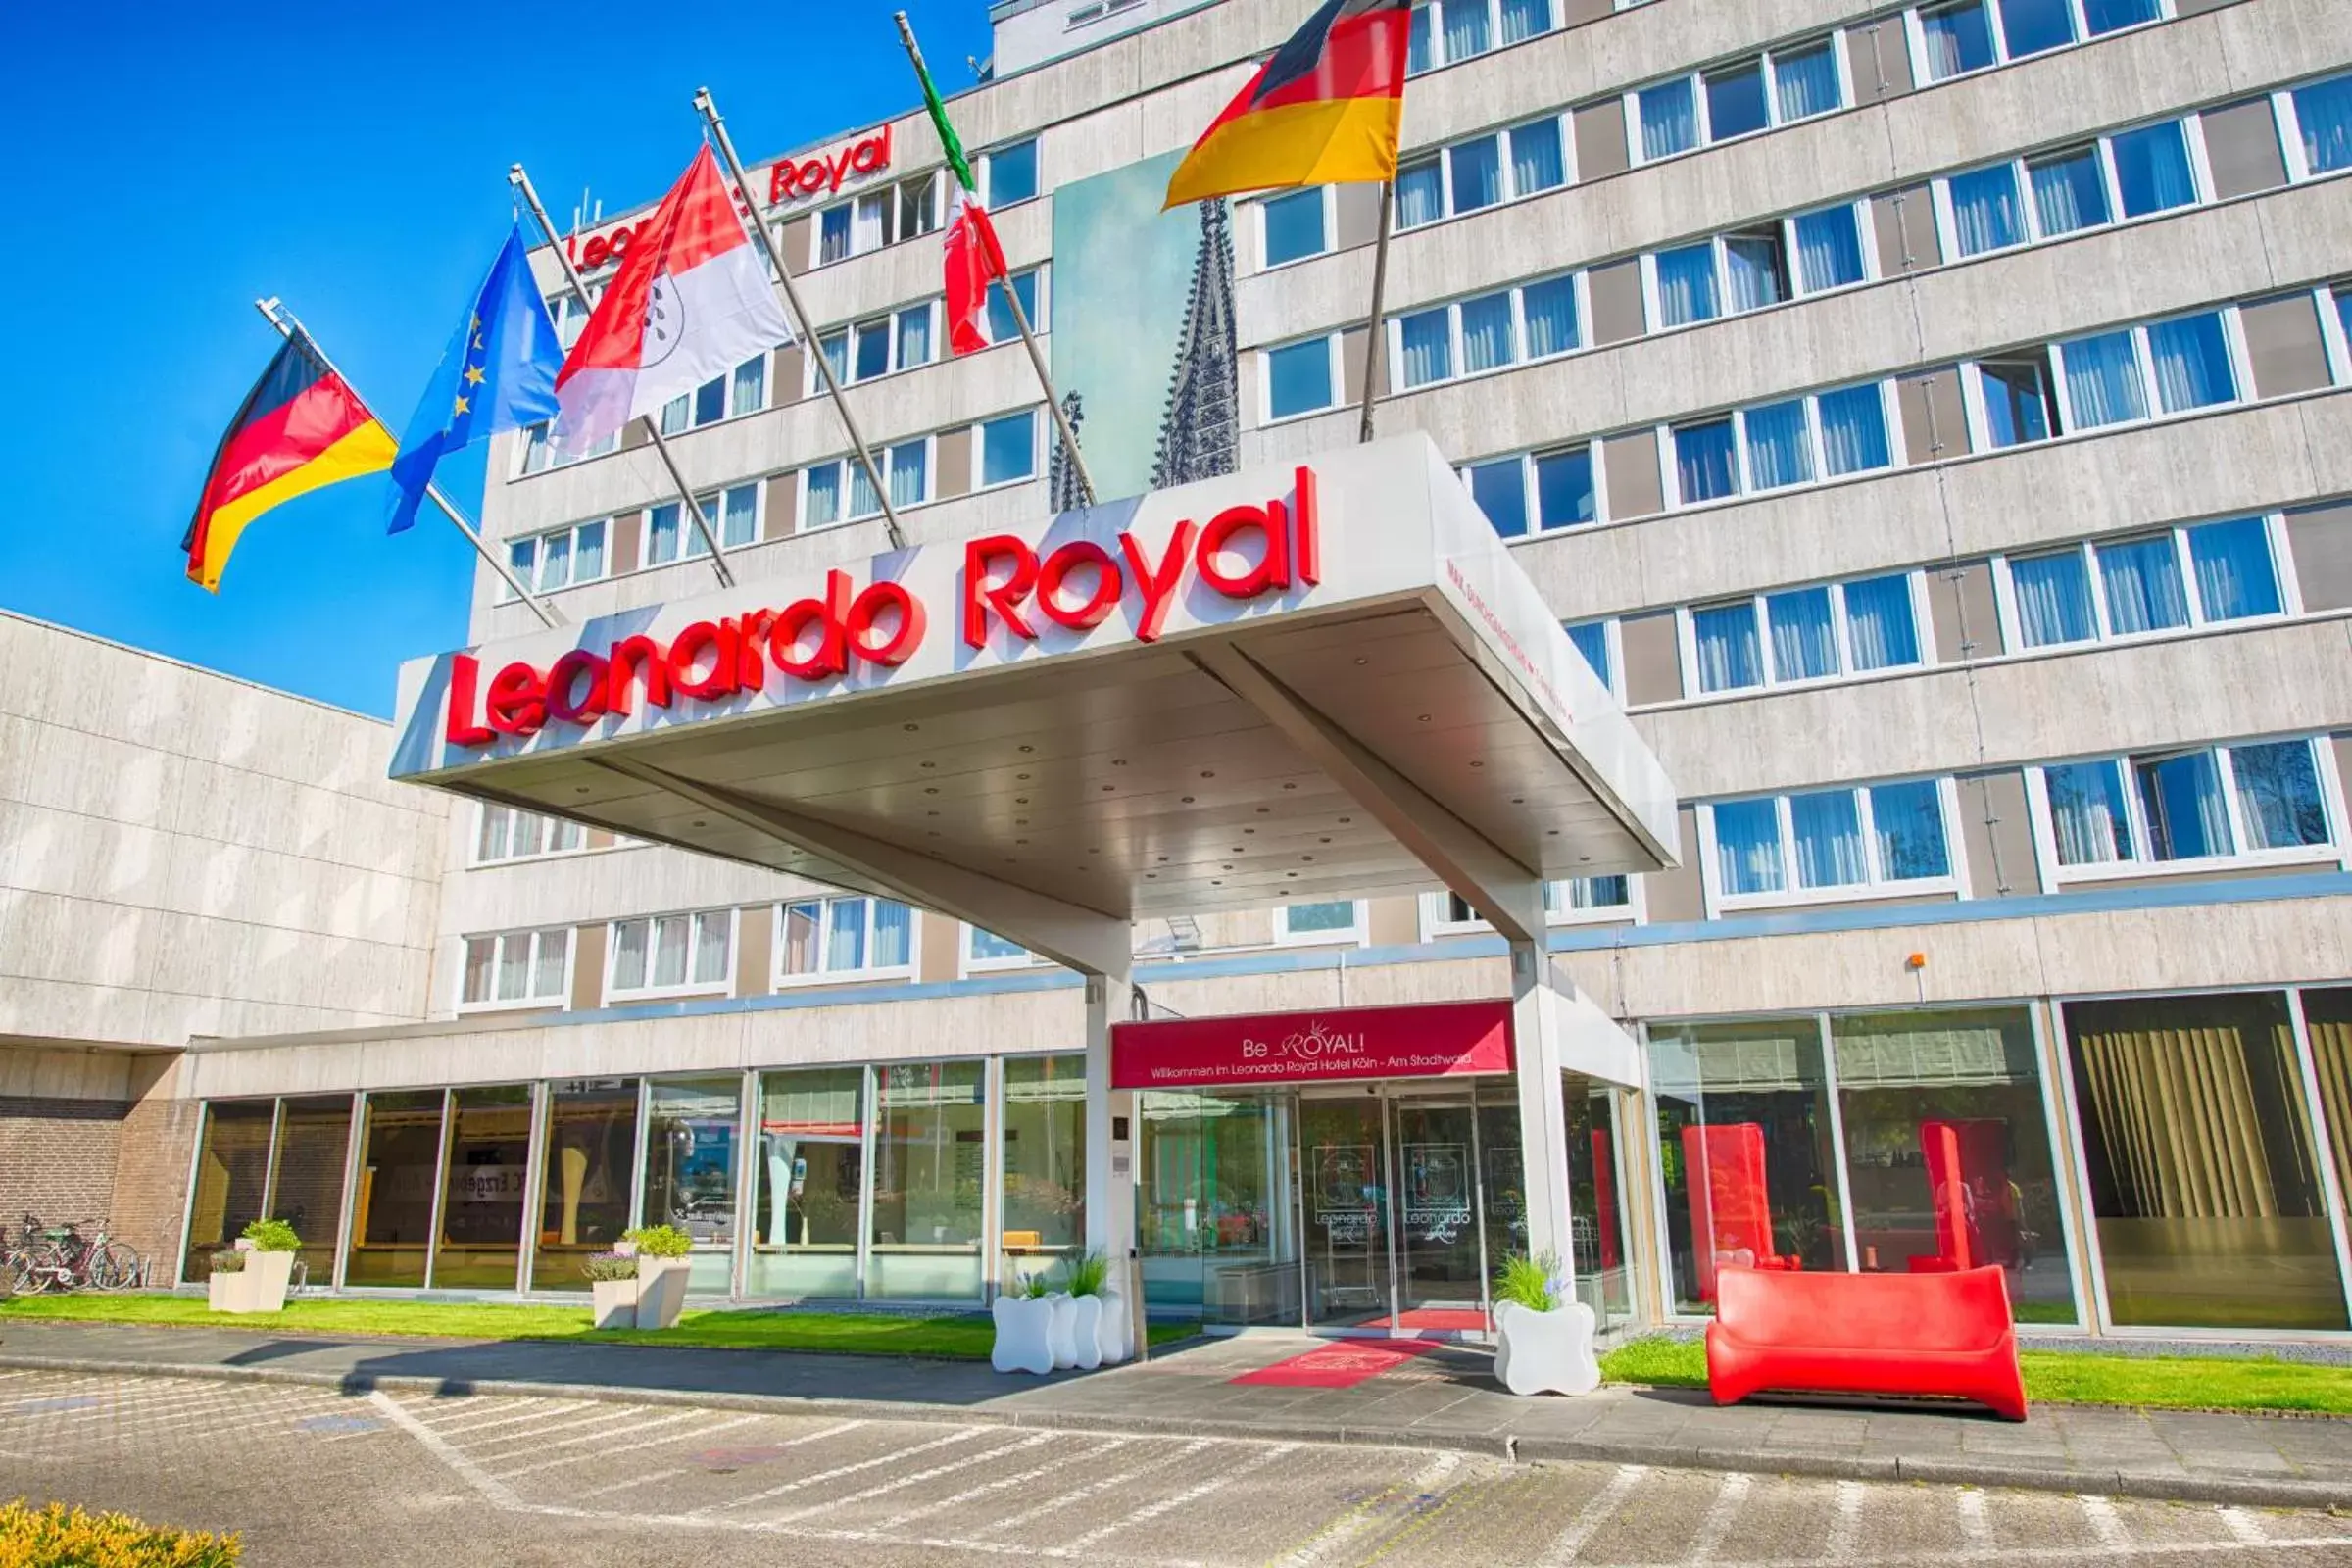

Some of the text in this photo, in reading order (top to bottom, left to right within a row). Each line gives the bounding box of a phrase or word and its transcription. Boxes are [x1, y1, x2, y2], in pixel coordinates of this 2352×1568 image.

[770, 123, 892, 204] Royal
[446, 568, 927, 747] Leonardo
[963, 466, 1319, 643] Royal
[1151, 1064, 1214, 1079] Willkommen
[1232, 1061, 1285, 1075] Leonardo
[1286, 1060, 1318, 1074] Royal
[1320, 1057, 1351, 1071] Hotel
[1352, 1056, 1378, 1069] Köln
[1387, 1055, 1408, 1067] Am
[1243, 1039, 1267, 1057] Be
